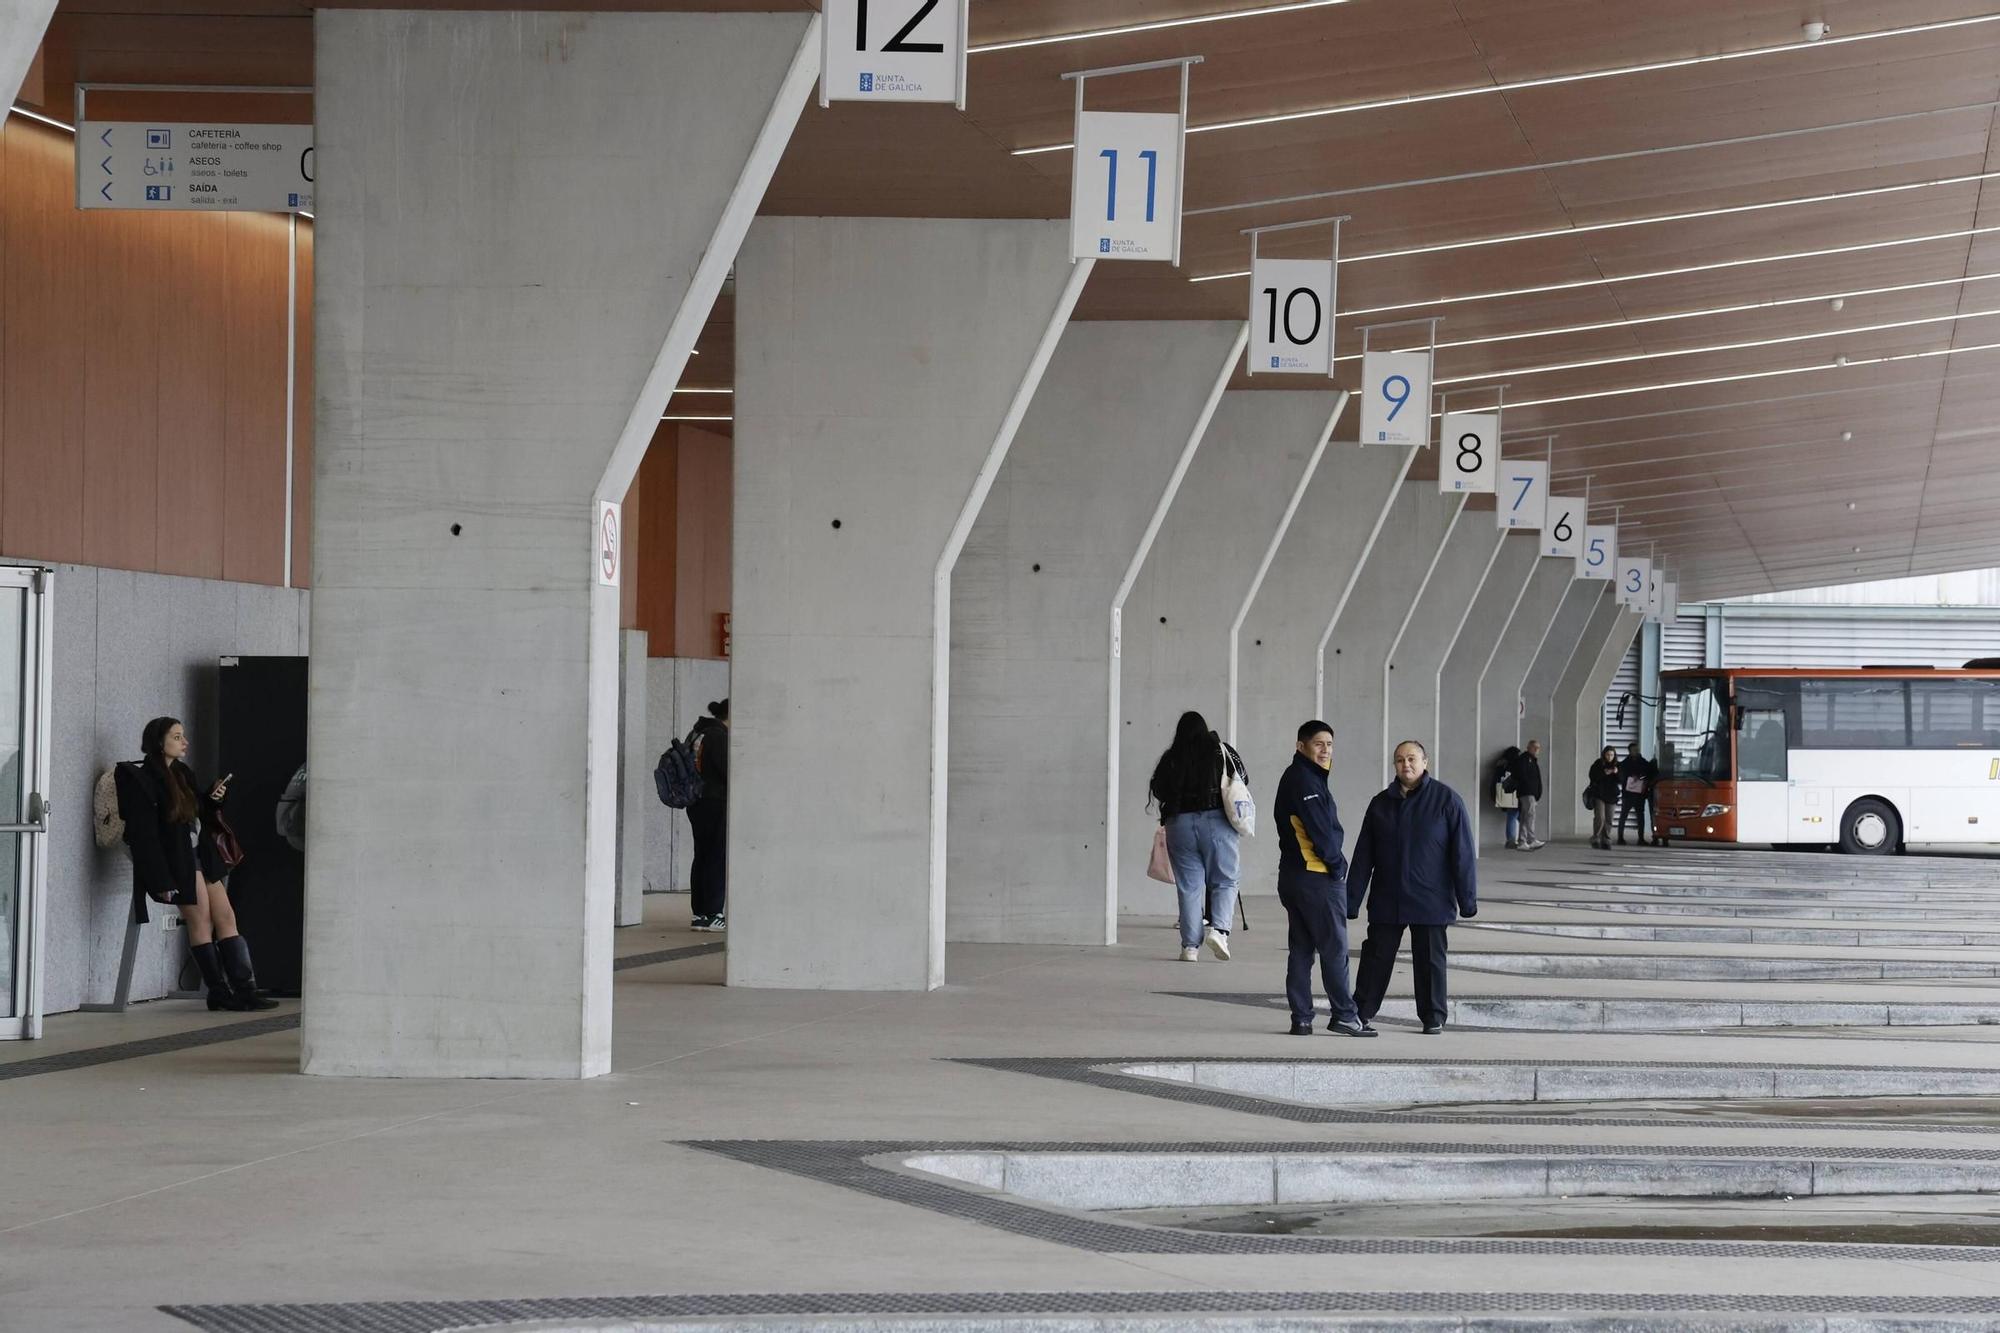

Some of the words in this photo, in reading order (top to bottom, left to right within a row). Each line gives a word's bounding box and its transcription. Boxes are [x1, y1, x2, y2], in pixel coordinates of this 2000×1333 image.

[875, 83, 886, 91] DE
[889, 83, 922, 91] GALICIA
[234, 142, 260, 150] coffee
[262, 142, 282, 151] shop
[188, 157, 221, 166] ASEOS
[223, 169, 248, 177] toilets
[189, 182, 218, 192] SAÍDA
[1100, 149, 1157, 222] 11
[223, 196, 238, 204] exit
[1263, 287, 1321, 345] 10
[1382, 375, 1411, 422] 9
[1456, 433, 1482, 473] 8
[1512, 477, 1533, 511] 7
[1553, 511, 1572, 542] 6
[1586, 539, 1605, 566] 5
[1625, 568, 1641, 592] 3
